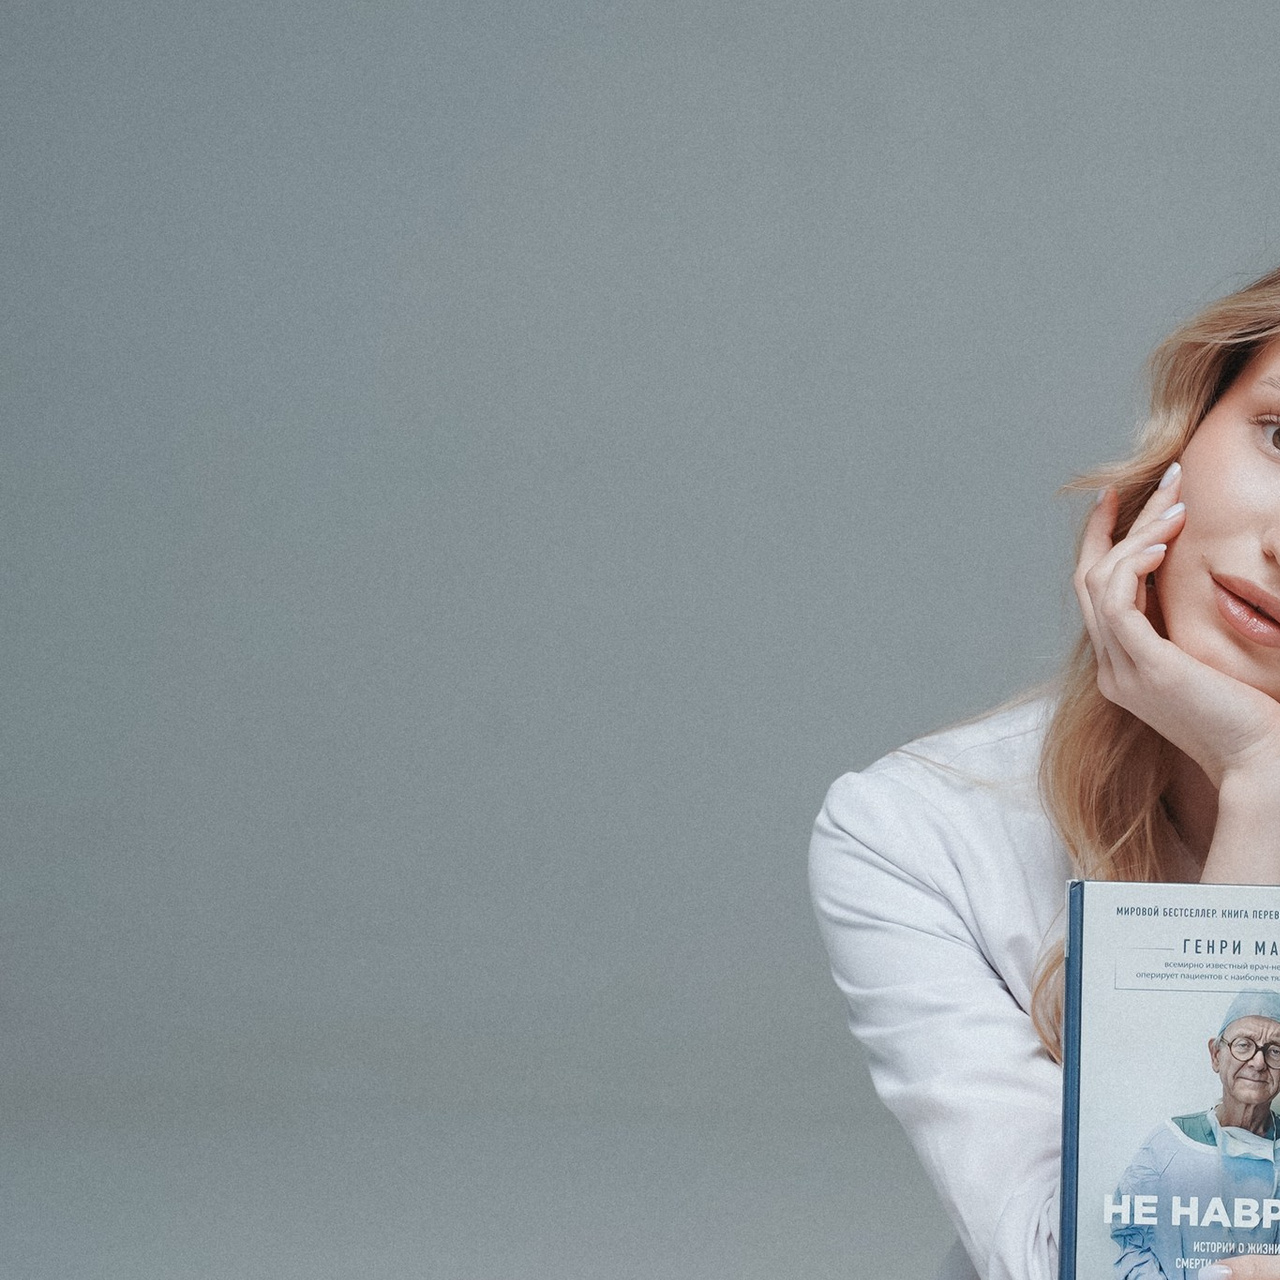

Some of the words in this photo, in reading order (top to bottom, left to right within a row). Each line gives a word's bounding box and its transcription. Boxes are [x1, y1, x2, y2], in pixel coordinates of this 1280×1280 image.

[1116, 906, 1159, 917] МИРОВОЙ
[1163, 907, 1217, 918] БЕСТСЕЛЛЕР.
[1221, 909, 1249, 919] КНИГА
[1183, 938, 1241, 955] ГЕНРИ
[1164, 961, 1204, 970] всемирно
[1206, 962, 1248, 970] известный
[1136, 971, 1179, 980] оперирует
[1181, 973, 1222, 981] пациентов
[1230, 973, 1269, 981] наиболее
[1103, 1194, 1158, 1225] НЕ
[1193, 1241, 1235, 1253] ИСТОРИИ
[1238, 1242, 1245, 1253] О
